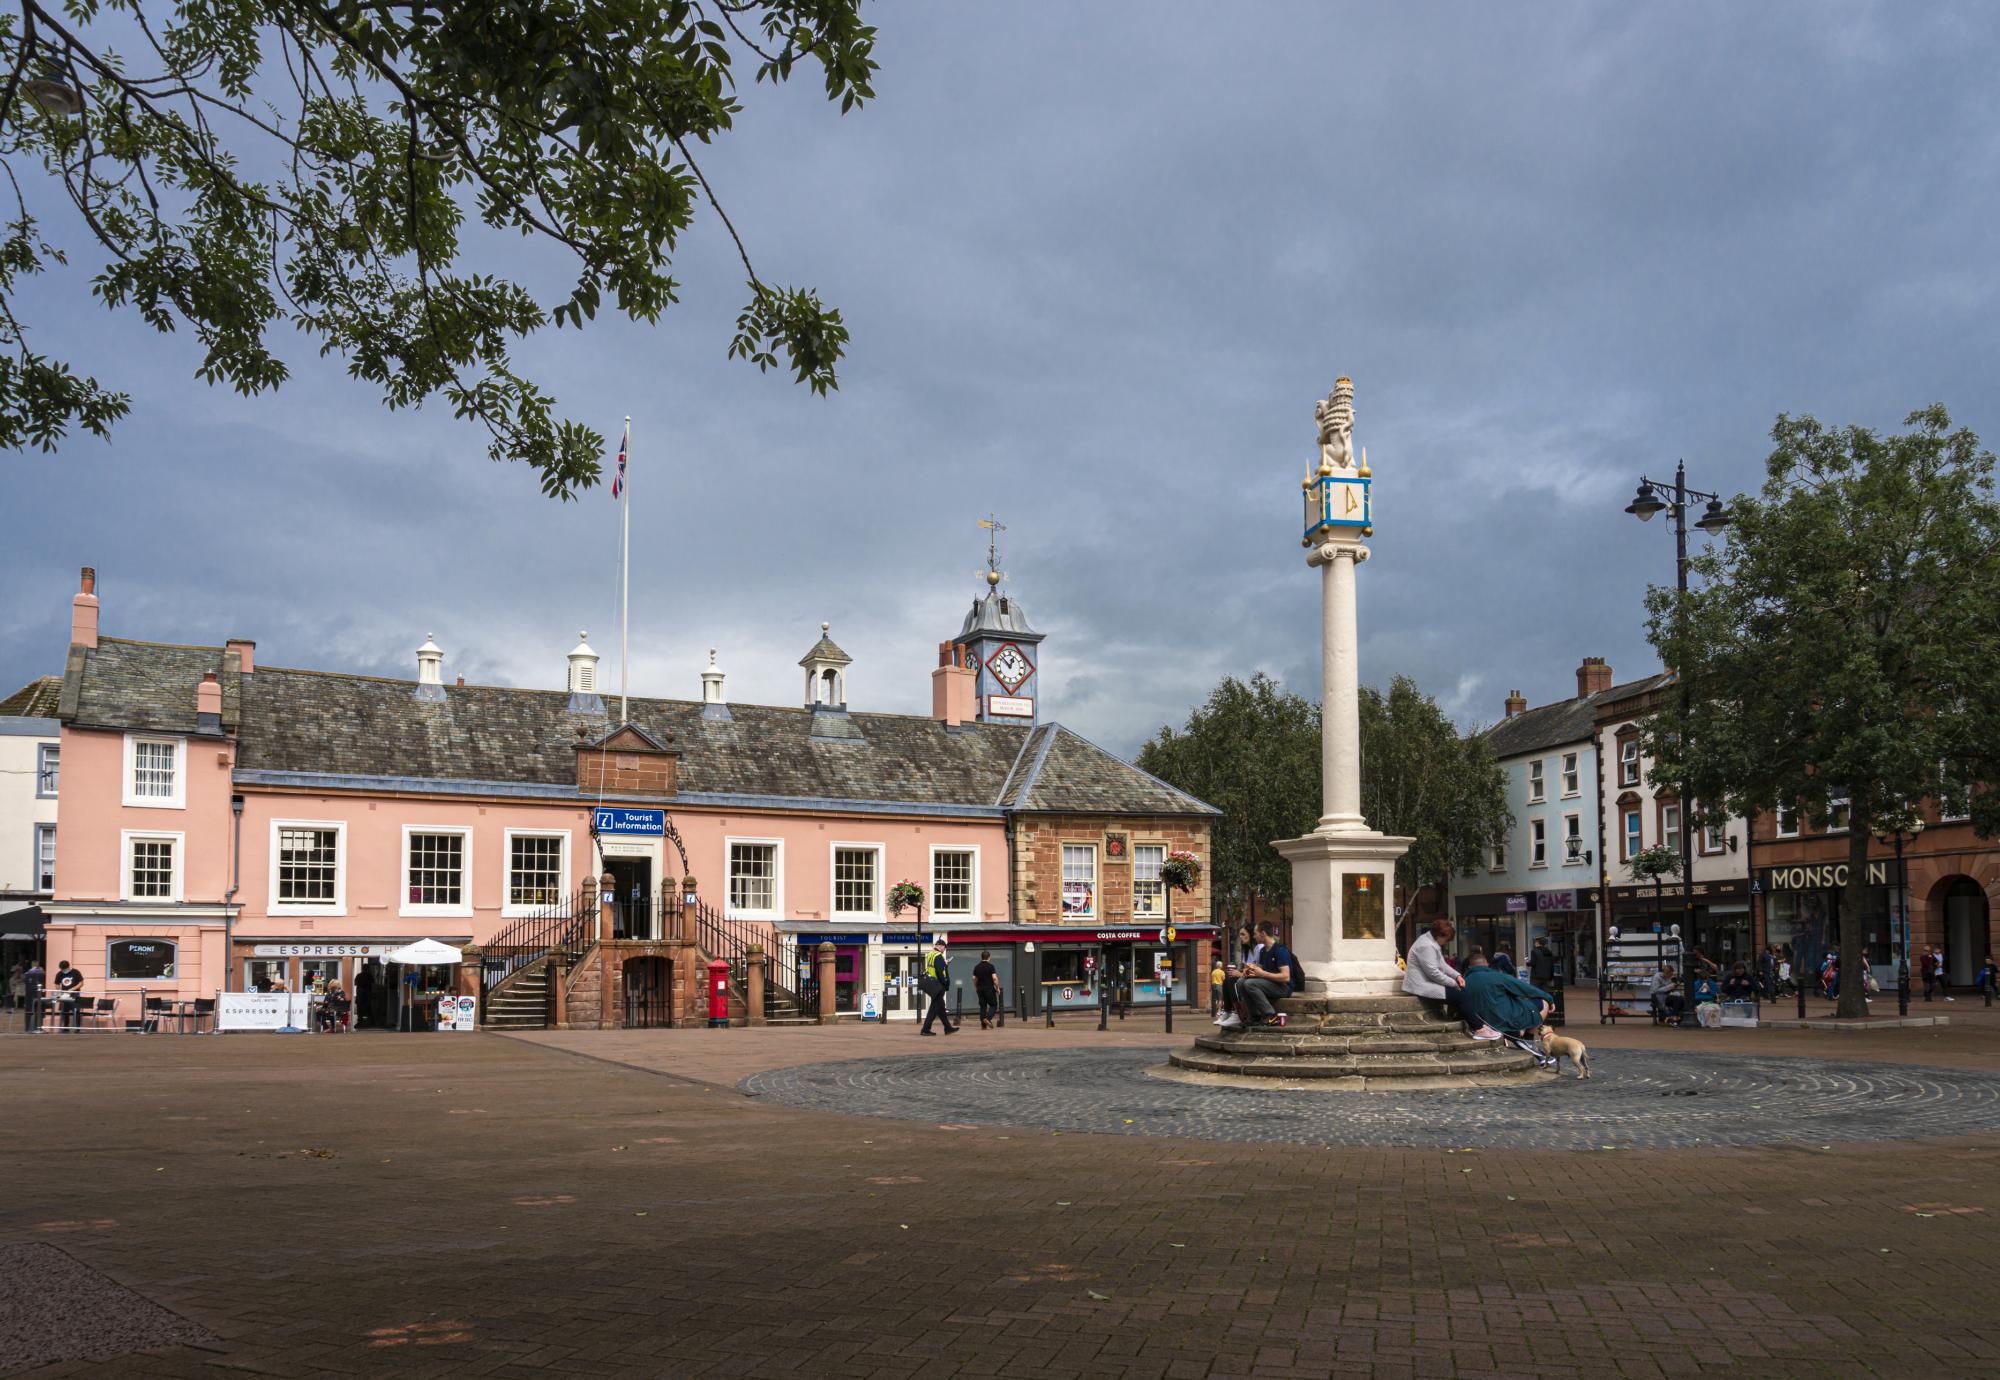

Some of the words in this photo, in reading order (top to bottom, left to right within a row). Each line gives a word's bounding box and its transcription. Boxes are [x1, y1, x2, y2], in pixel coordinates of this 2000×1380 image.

[625, 813, 653, 822] Tourist
[615, 821, 662, 831] Information
[1772, 862, 1886, 889] MONSON
[1537, 892, 1572, 910] GAME
[129, 944, 155, 952] PERONI
[280, 946, 370, 955] ESPRESSO
